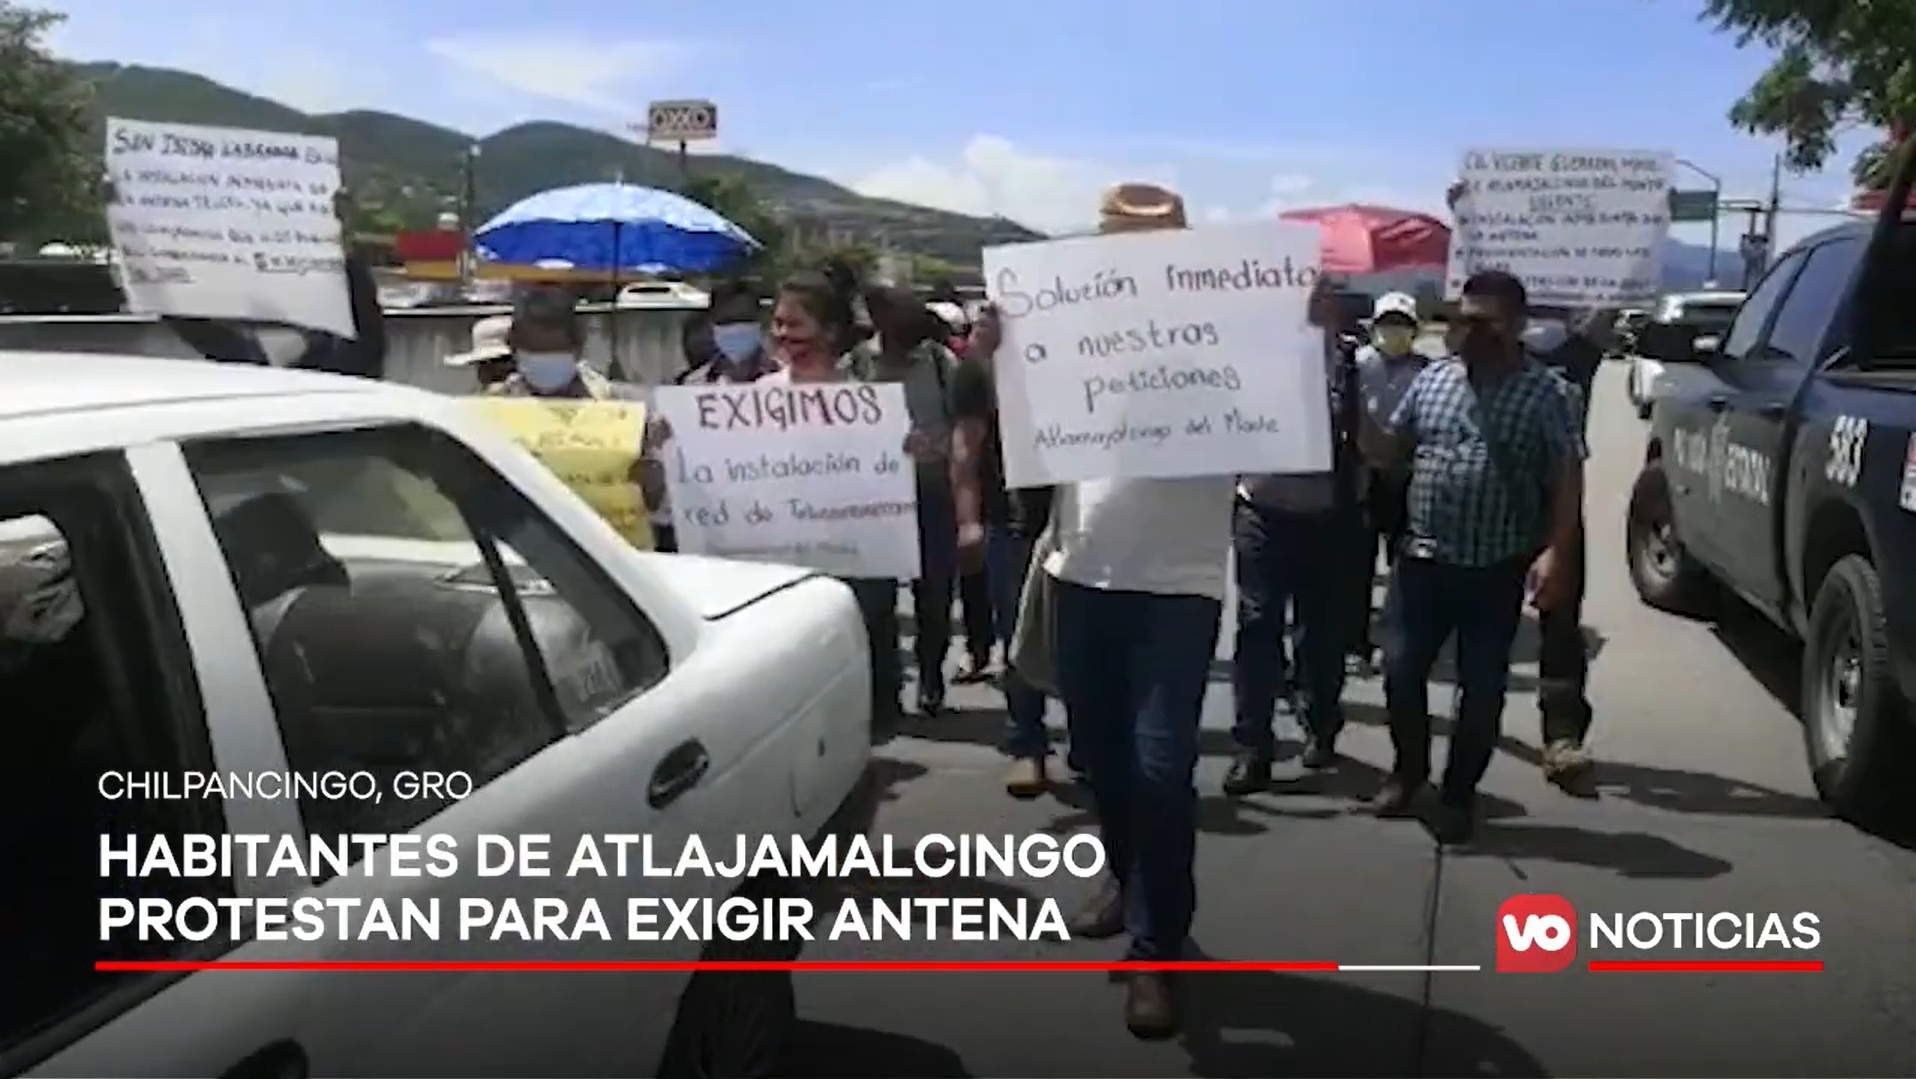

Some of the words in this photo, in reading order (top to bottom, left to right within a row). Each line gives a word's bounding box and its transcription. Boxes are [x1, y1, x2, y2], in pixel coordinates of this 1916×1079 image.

[651, 108, 711, 130] OXXO
[1025, 343, 1047, 364] a
[1078, 318, 1219, 356] nuestras
[697, 385, 882, 432] EXIGIMOS
[1083, 365, 1241, 414] peticiones
[677, 446, 713, 483] La
[724, 450, 861, 483] instalación
[874, 452, 900, 475] de
[685, 501, 730, 527] red
